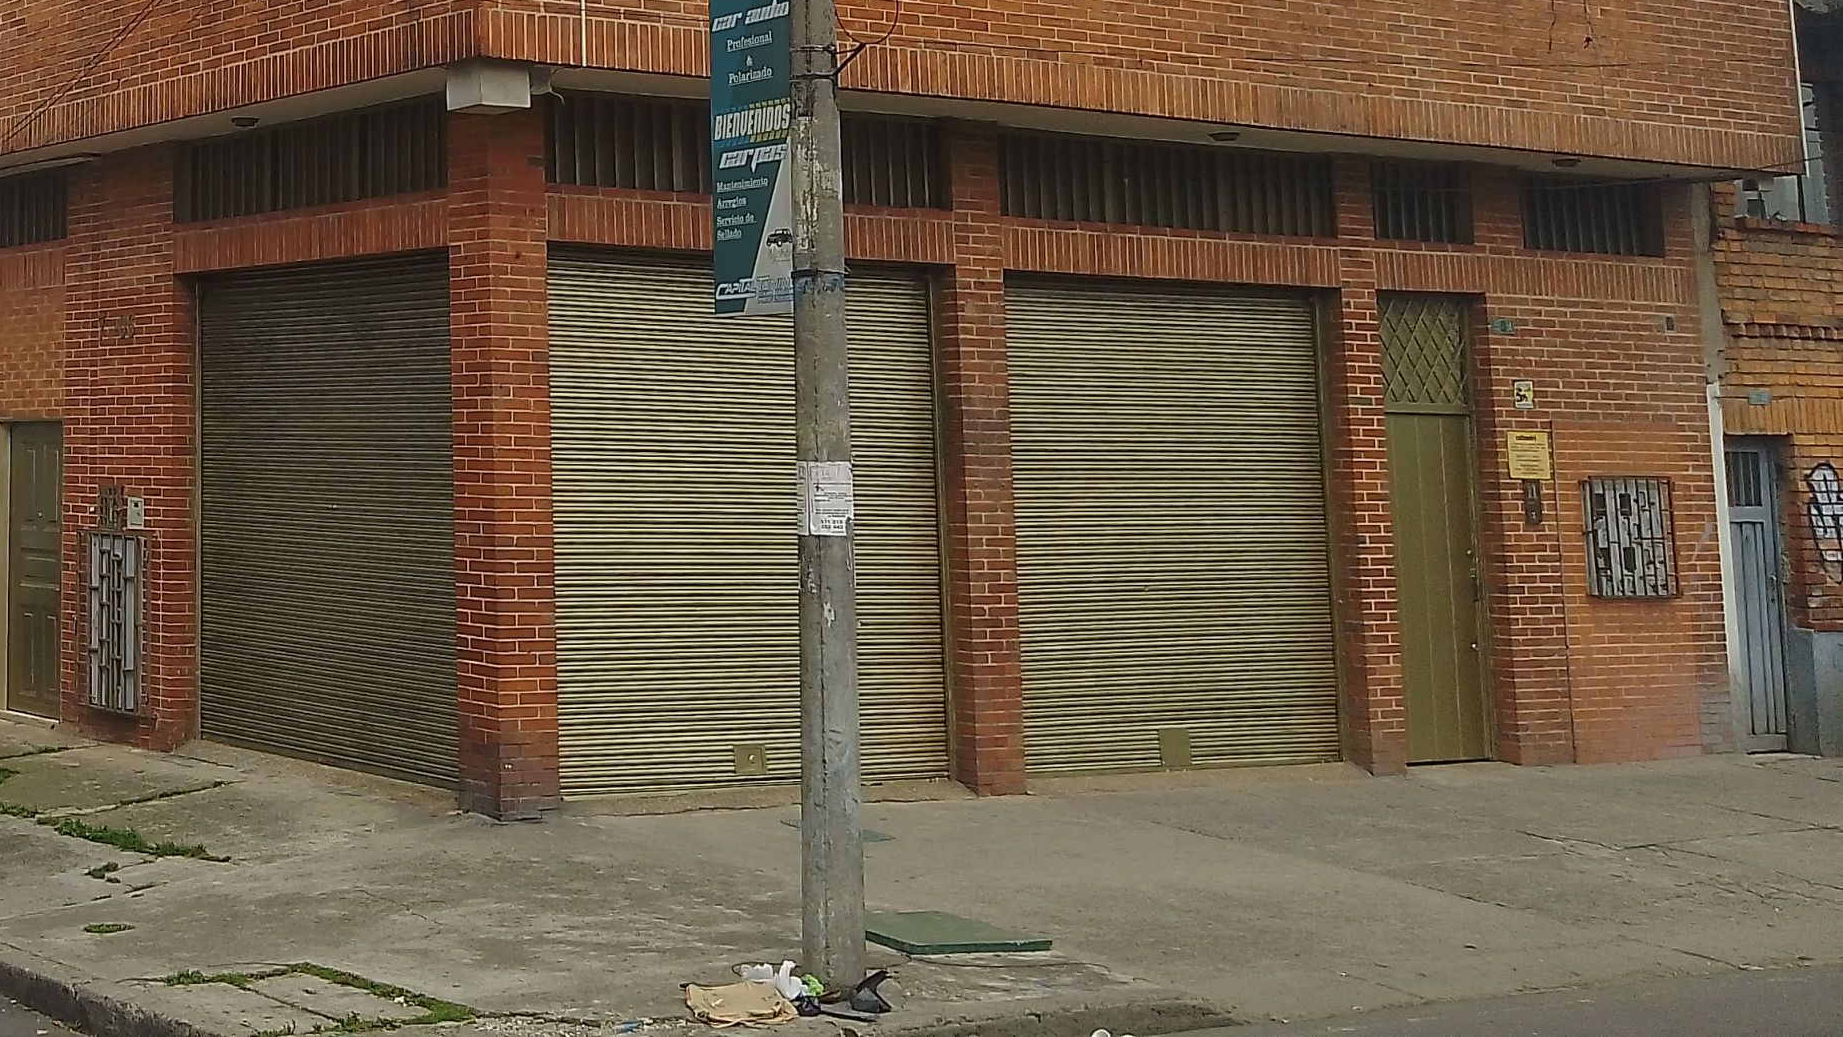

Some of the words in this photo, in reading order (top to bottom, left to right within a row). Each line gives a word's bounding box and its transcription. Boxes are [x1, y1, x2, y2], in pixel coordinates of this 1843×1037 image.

[712, 12, 743, 32] car
[726, 30, 772, 52] Profesional
[728, 66, 773, 85] Polarizado
[714, 103, 791, 141] BIENVENIDOS
[719, 143, 788, 173] carpas
